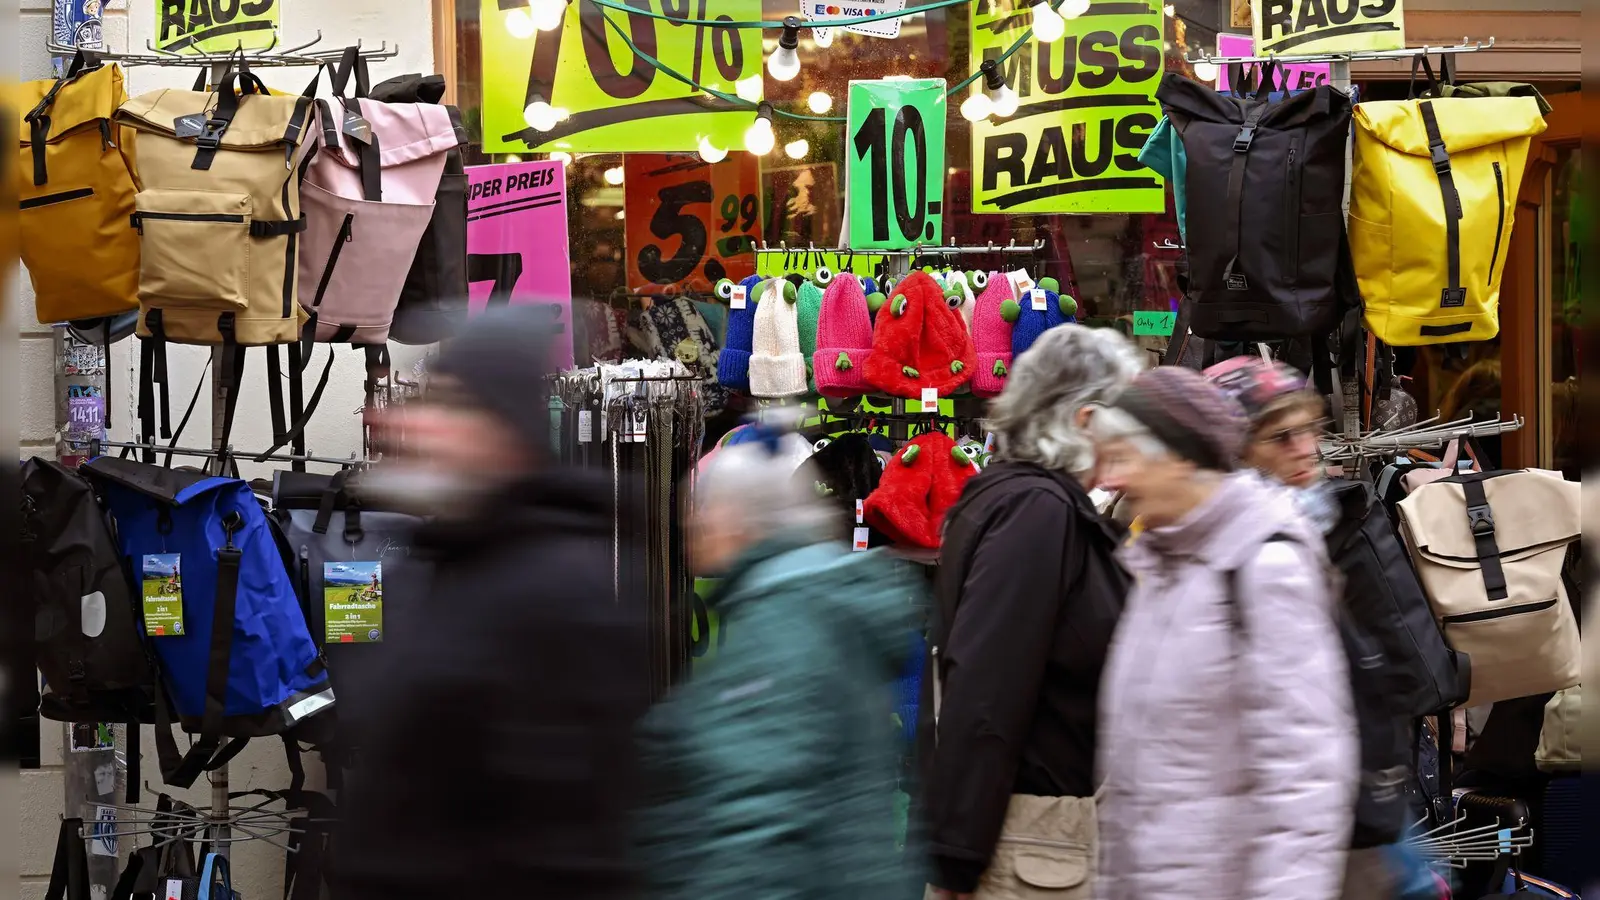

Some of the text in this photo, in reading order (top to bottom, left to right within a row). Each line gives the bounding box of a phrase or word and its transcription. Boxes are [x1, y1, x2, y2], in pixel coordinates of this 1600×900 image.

[843, 7, 863, 16] VISA
[982, 24, 1161, 98] MUSS
[982, 113, 1158, 192] RAUS
[506, 167, 555, 193] PREIS
[1137, 318, 1154, 329] Only
[329, 602, 377, 610] Fahrradtasche
